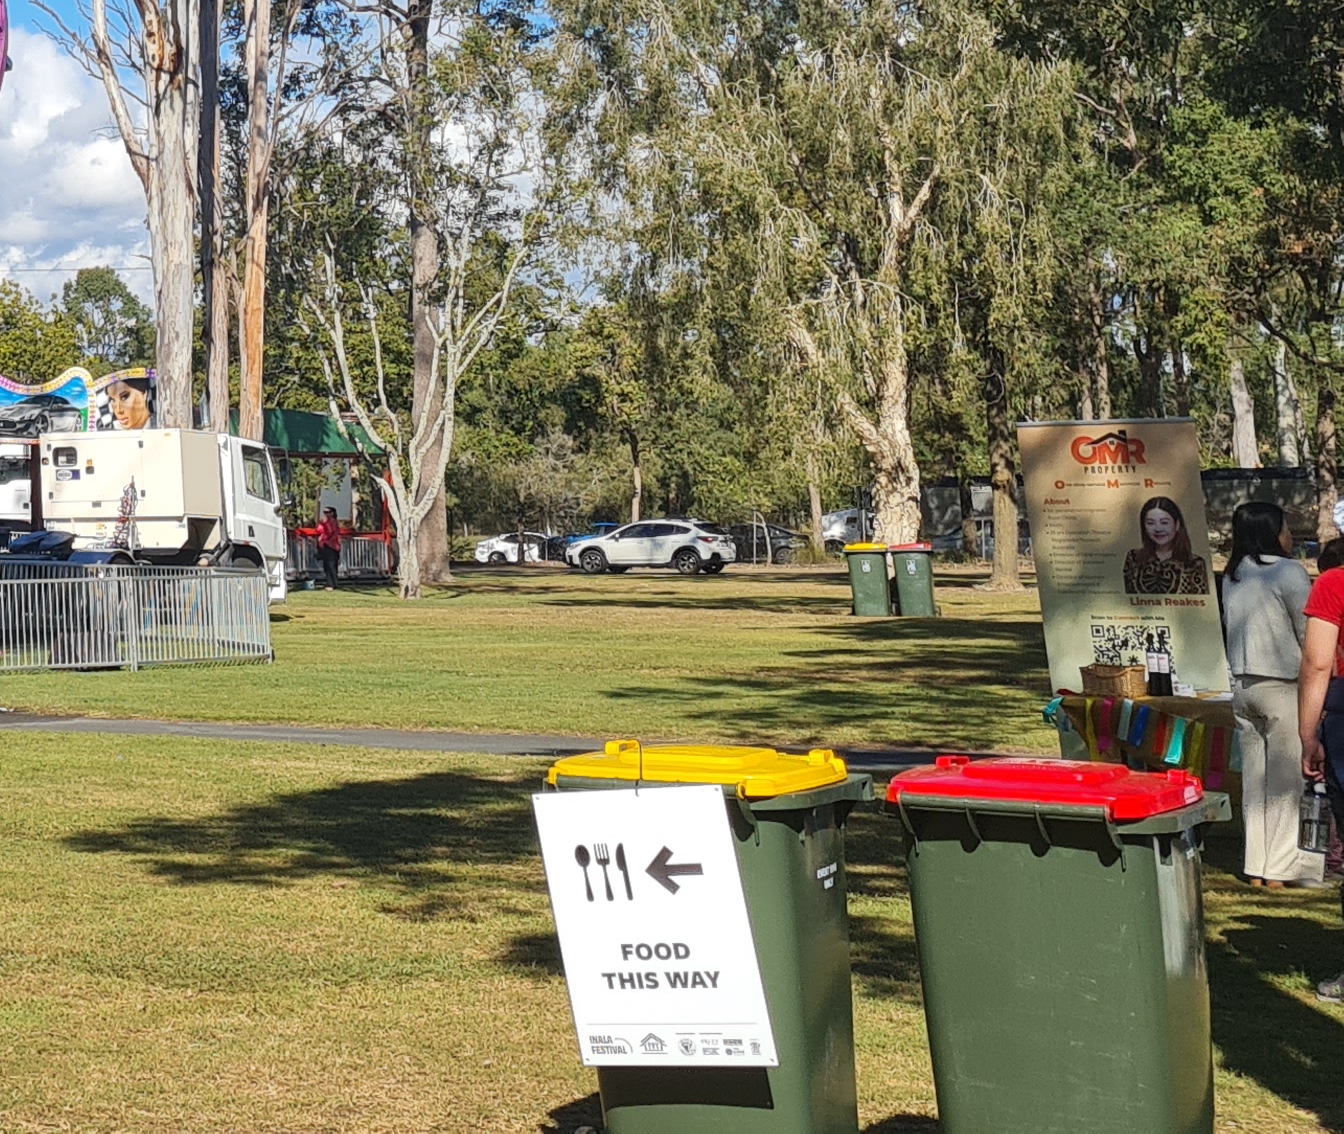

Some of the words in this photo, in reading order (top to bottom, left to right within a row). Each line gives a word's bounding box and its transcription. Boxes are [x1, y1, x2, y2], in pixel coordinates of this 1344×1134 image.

[1071, 436, 1146, 465] OMR
[1084, 466, 1136, 474] PROPERTY
[1130, 597, 1161, 606] Linna
[621, 942, 690, 961] FOOD
[601, 971, 659, 990] THIS
[664, 971, 720, 989] WAY
[589, 1035, 613, 1044] INALA
[590, 1046, 628, 1055] FESTIVAL
